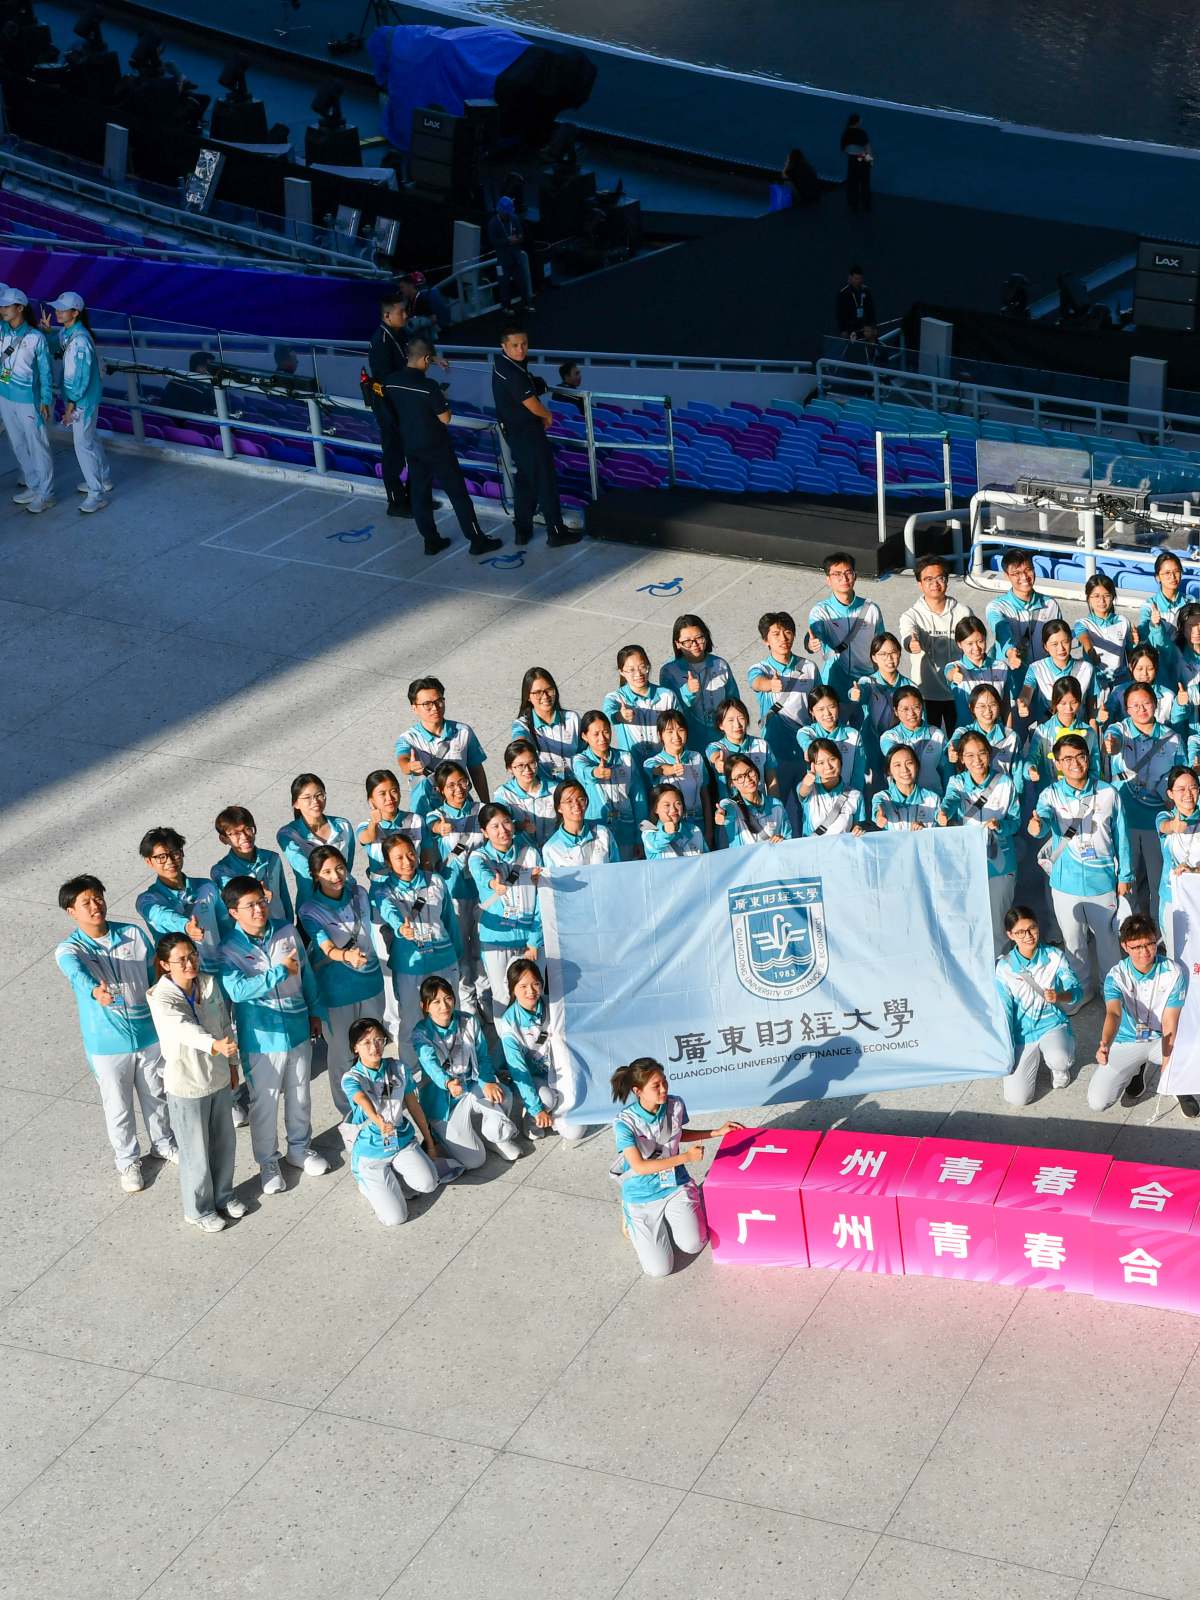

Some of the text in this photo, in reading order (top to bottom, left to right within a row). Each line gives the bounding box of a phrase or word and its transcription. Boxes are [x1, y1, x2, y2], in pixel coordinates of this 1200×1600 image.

[1155, 255, 1180, 267] LAX
[774, 970, 796, 979] 1983
[668, 998, 914, 1064] 廣東財經大學
[669, 1064, 735, 1081] GUANGDONG
[737, 1055, 792, 1070] UNIVERSITY
[793, 1052, 808, 1062] OF
[809, 1047, 852, 1060] FINANCE
[863, 1040, 919, 1053] ECONOMICS
